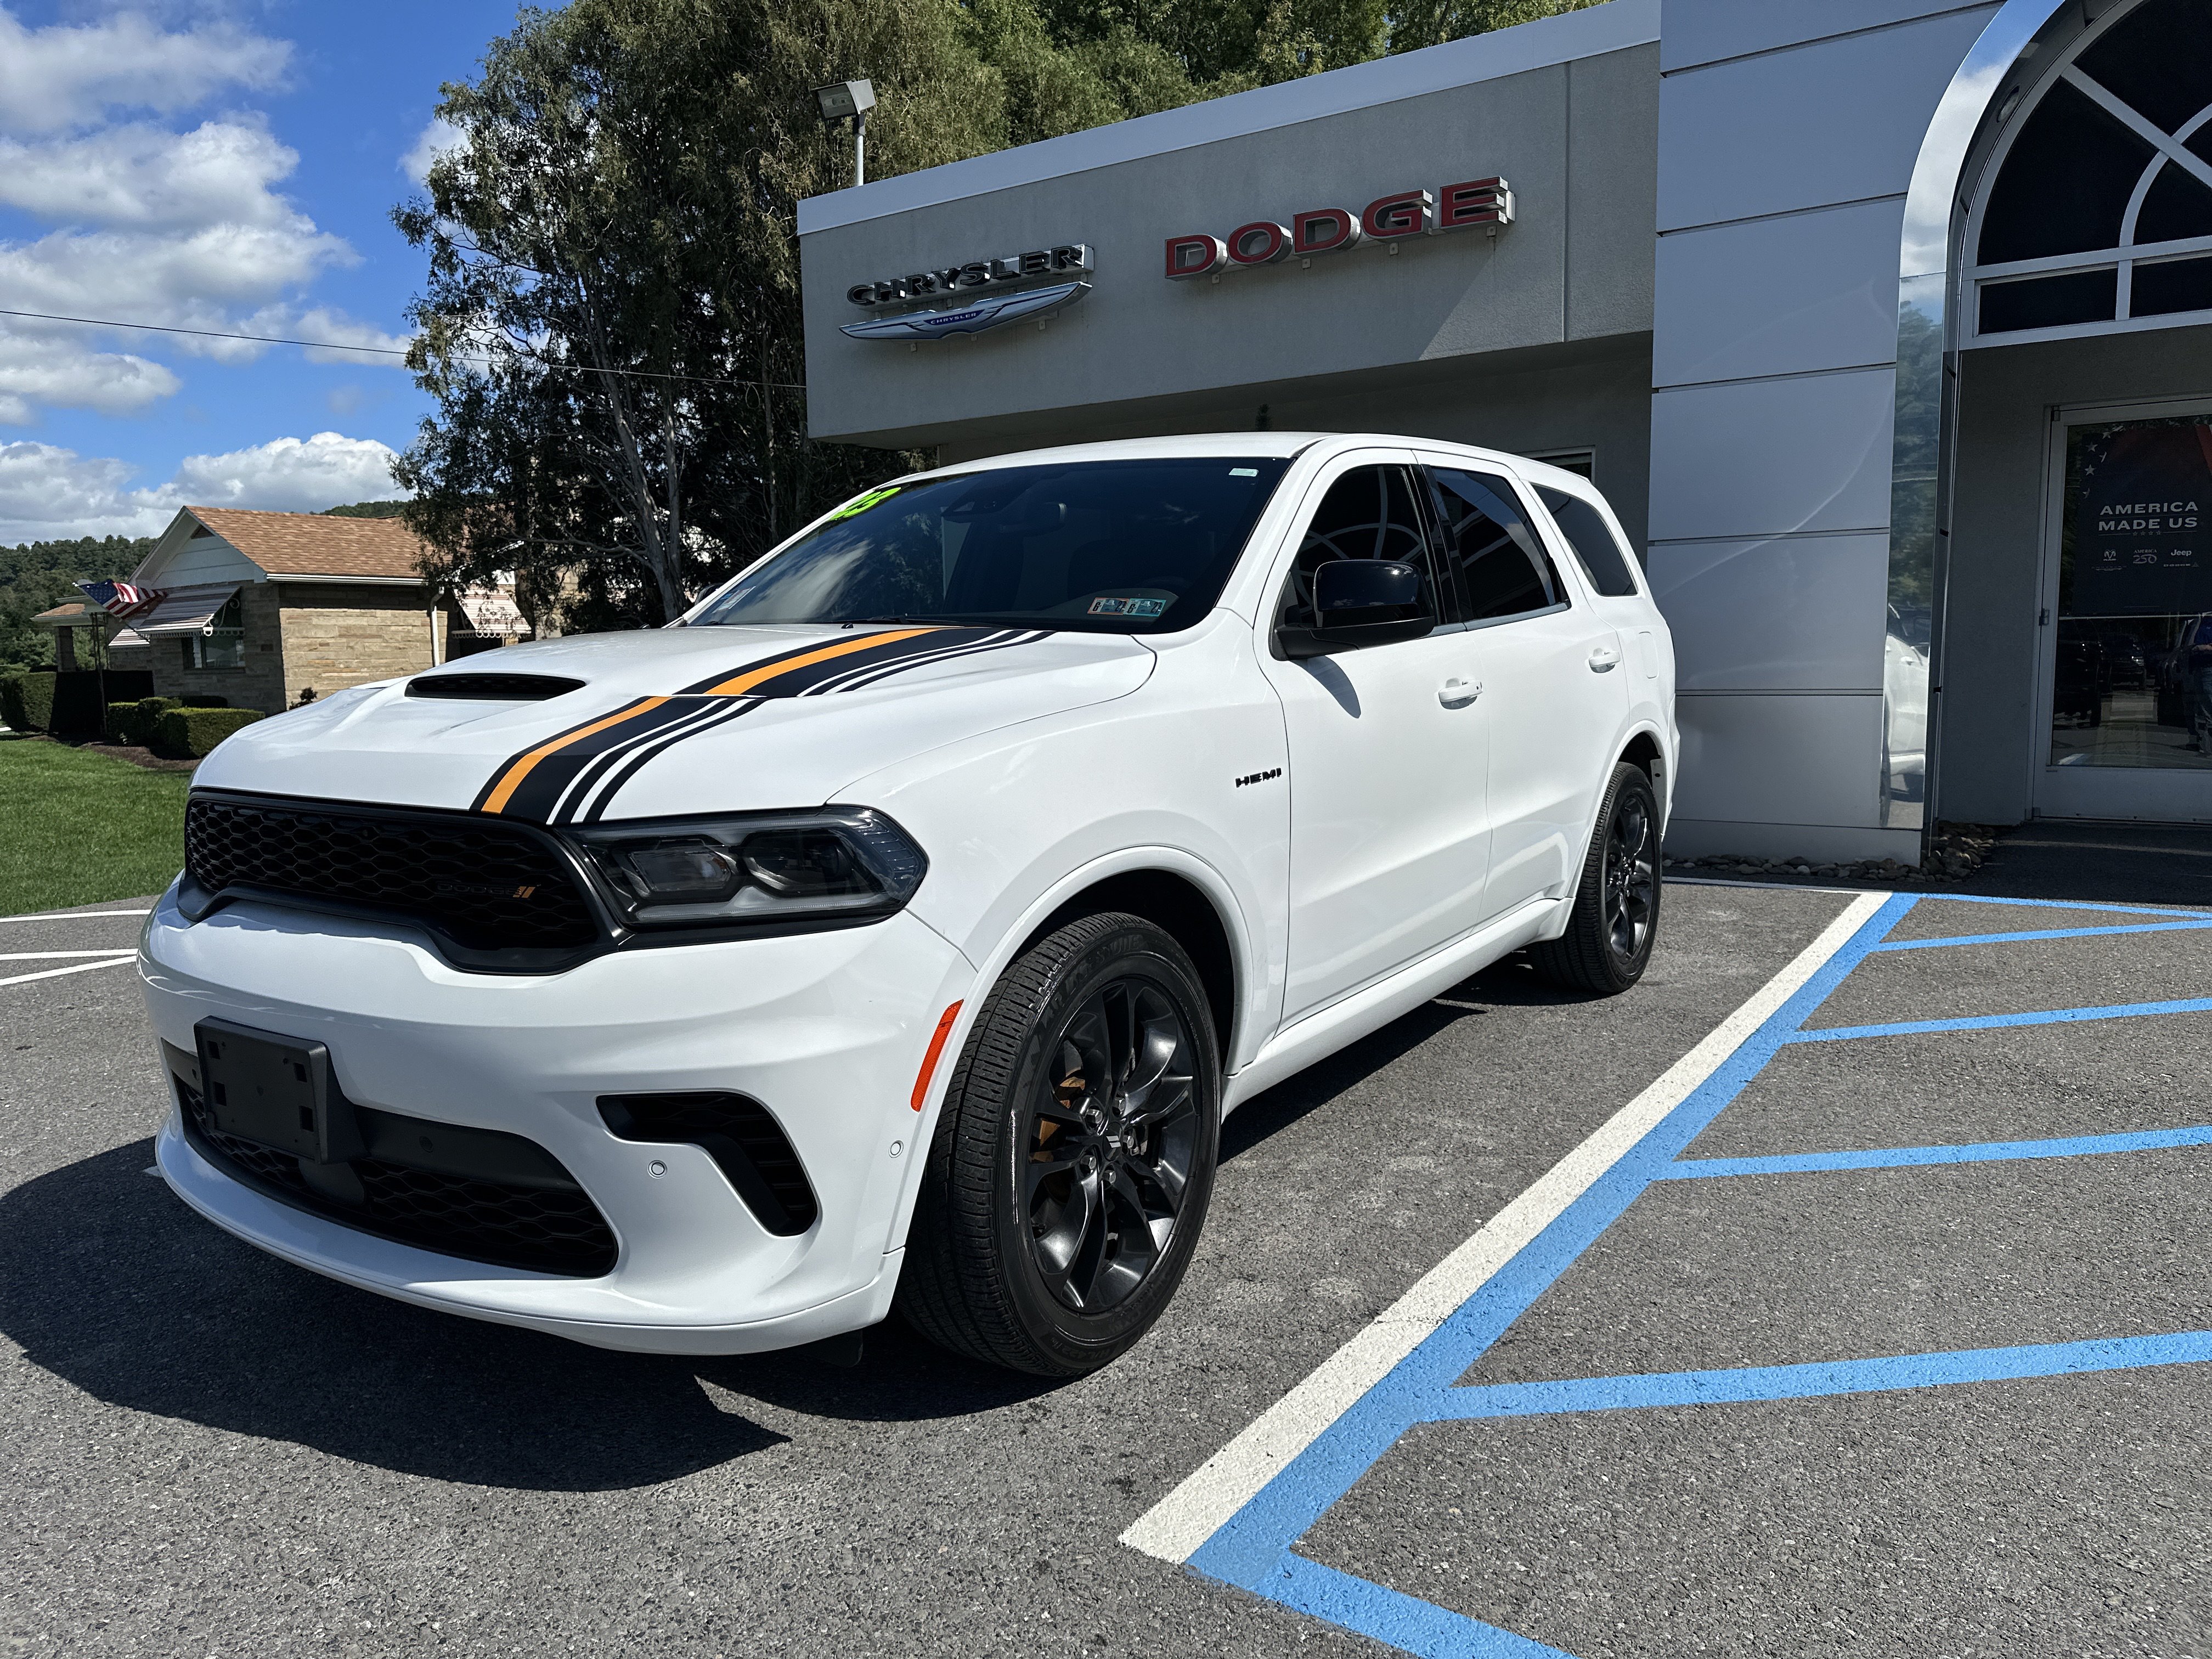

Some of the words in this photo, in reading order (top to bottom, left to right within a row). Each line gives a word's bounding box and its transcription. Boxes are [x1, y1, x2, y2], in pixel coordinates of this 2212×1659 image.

[1165, 176, 1506, 280] DODGE
[847, 245, 1083, 306] CHRYSLER
[930, 312, 977, 324] CHRYSLER
[2100, 501, 2198, 515] AMERICA
[2098, 519, 2160, 531] MADE
[2169, 517, 2198, 528] US
[2132, 554, 2157, 564] 250
[2170, 549, 2192, 557] Jeep
[1235, 767, 1282, 788] HEMI
